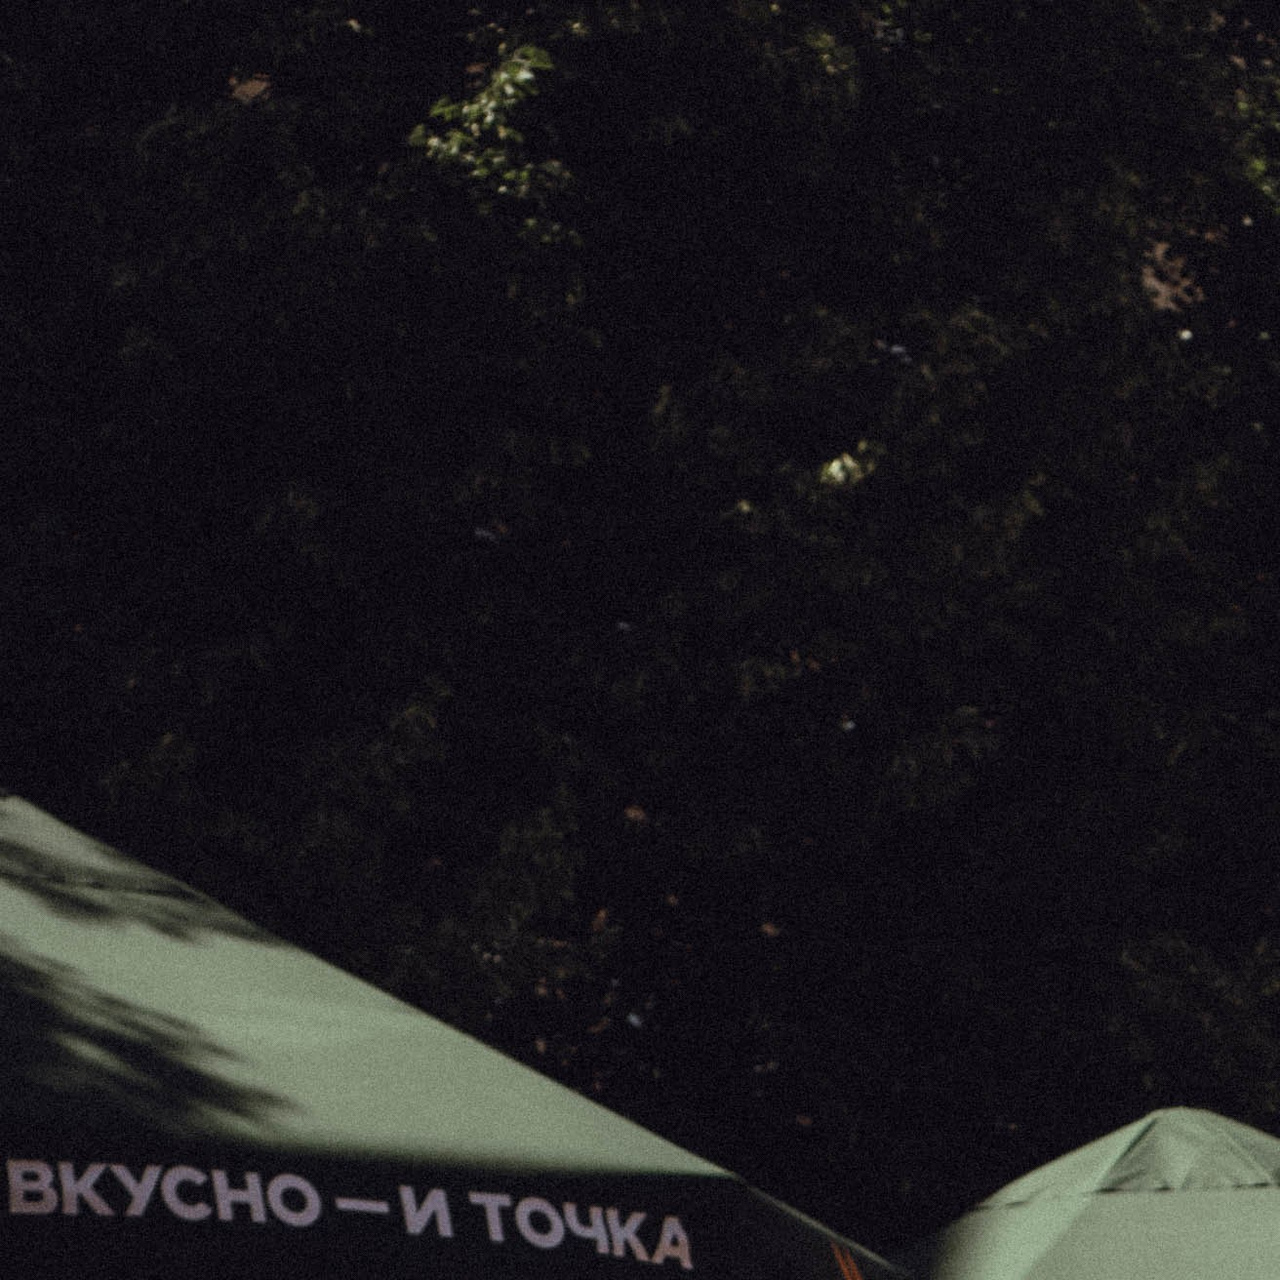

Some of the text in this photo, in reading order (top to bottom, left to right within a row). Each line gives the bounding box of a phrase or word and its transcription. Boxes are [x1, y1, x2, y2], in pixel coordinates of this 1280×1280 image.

[7, 1158, 324, 1228] ВКУСНО
[400, 1185, 454, 1239] И
[468, 1190, 694, 1270] ТОЧКА
